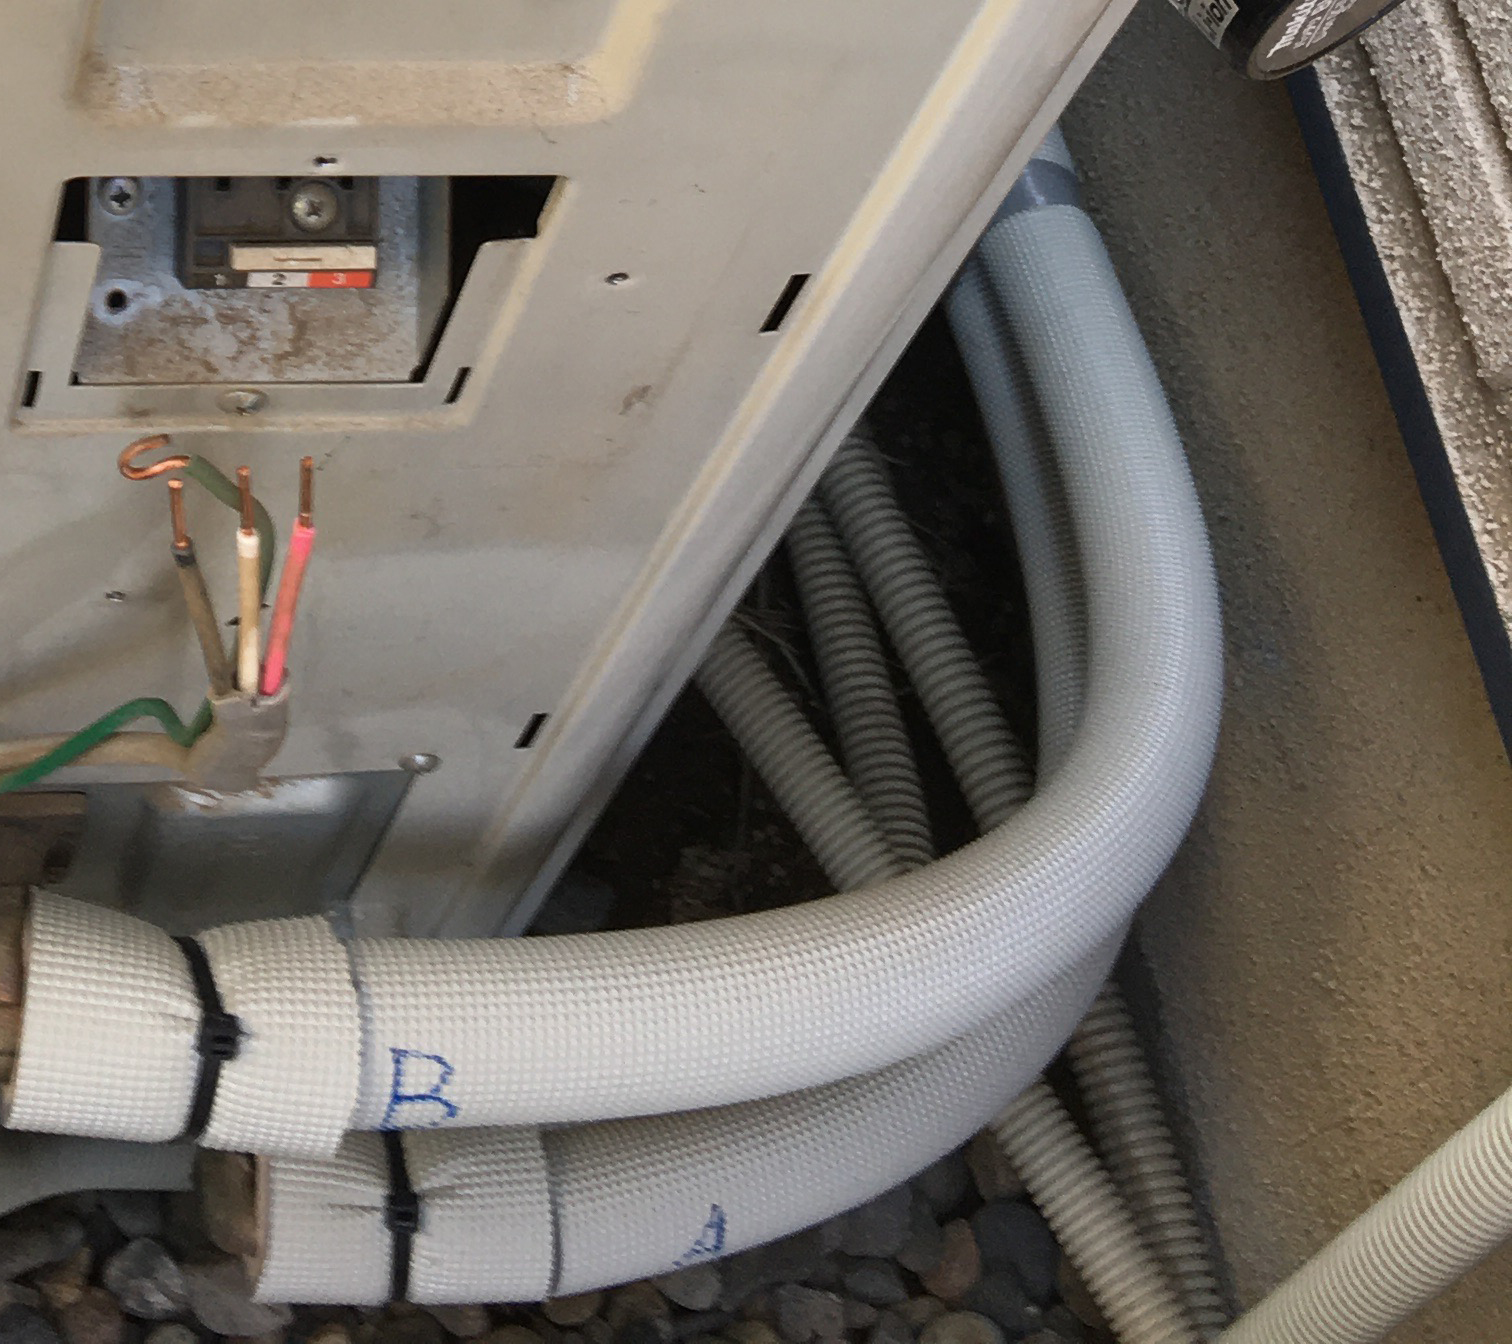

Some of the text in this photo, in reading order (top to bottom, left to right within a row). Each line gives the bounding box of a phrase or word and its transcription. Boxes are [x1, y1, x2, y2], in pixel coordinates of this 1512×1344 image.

[271, 273, 287, 286] 2
[331, 272, 347, 285] 3
[379, 1047, 458, 1132] B
